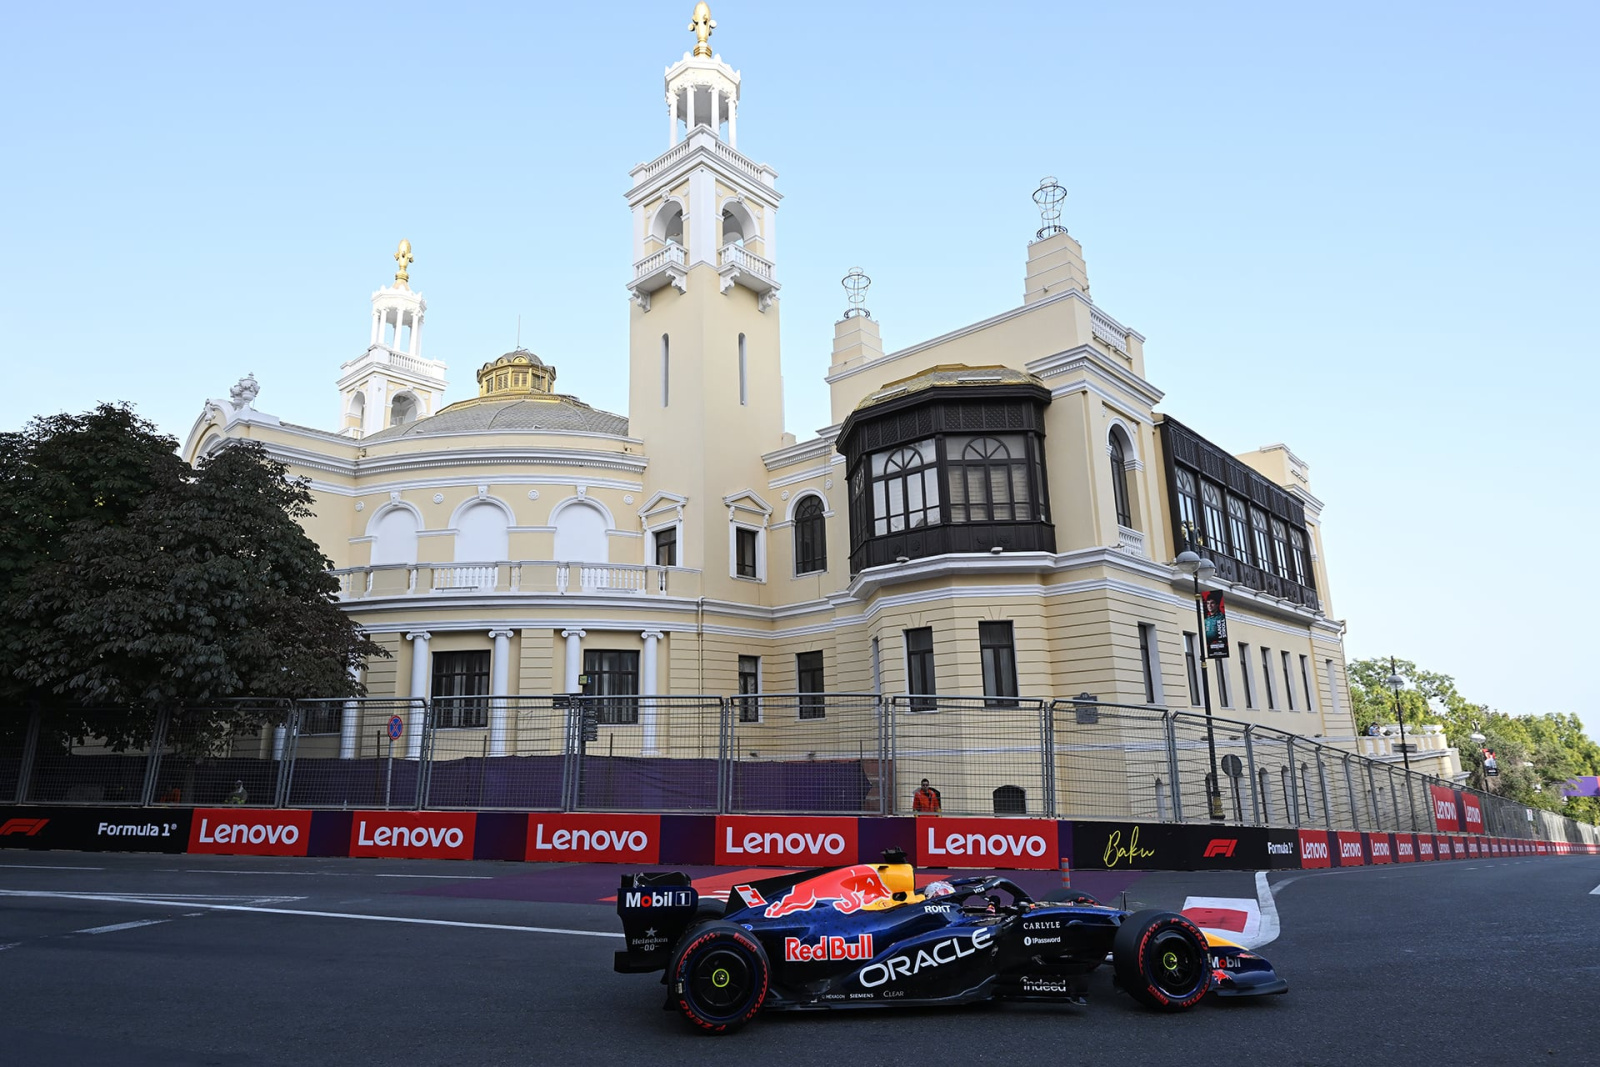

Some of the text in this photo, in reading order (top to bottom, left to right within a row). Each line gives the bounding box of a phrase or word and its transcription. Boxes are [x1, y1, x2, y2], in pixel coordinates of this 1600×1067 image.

[1433, 795, 1456, 820] Lenovo
[98, 822, 159, 836] Formula
[199, 818, 299, 844] Lenovo
[358, 821, 464, 848] Lenovo
[536, 824, 648, 852] Lenovo
[726, 826, 846, 854] Lenovo
[928, 828, 1047, 856] Lenovo
[1103, 826, 1155, 868] Baku
[1268, 842, 1288, 854] Formula
[1301, 838, 1328, 859] Lenovo
[1339, 839, 1362, 858] Lenovo
[1371, 840, 1390, 856] Lenovo
[1396, 840, 1413, 856] Lenovo
[626, 892, 672, 908] Mobil
[1024, 922, 1060, 930] CARLYLE
[785, 934, 873, 961] Red Bull
[859, 927, 994, 988] ORACLE
[1024, 978, 1066, 992] indeed
